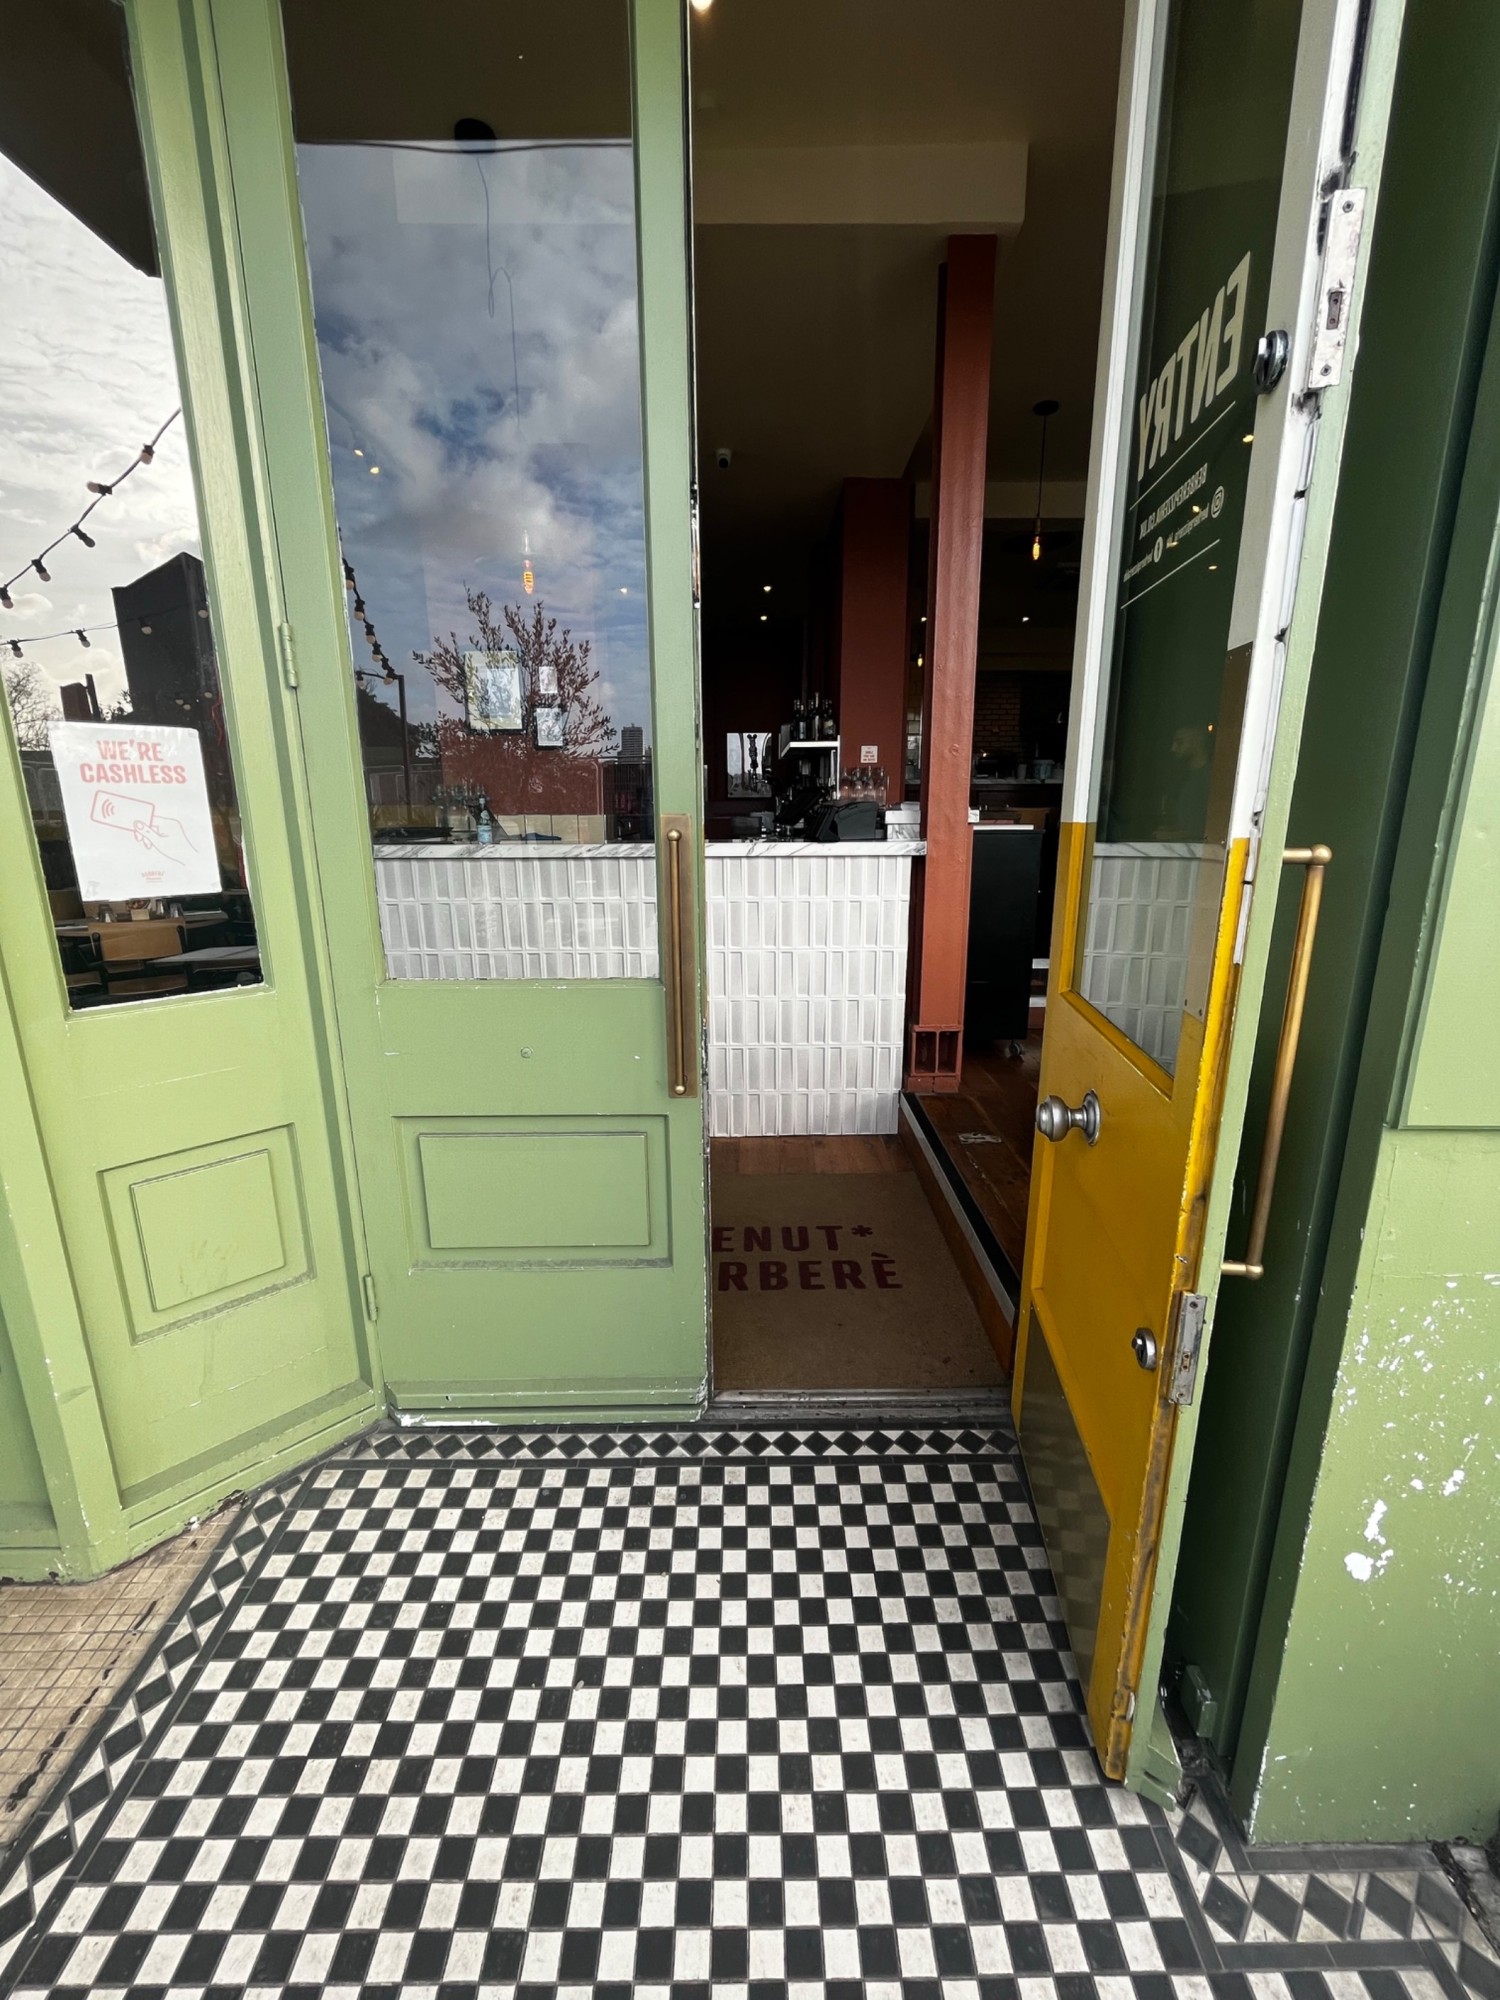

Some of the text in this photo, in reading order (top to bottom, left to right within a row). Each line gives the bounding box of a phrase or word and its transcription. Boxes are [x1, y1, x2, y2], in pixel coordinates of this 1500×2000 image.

[96, 739, 164, 762] WE'RE
[80, 763, 187, 784] CASHLESS
[712, 1225, 873, 1252] ENUT
[718, 1252, 903, 1291] RBERÈ
